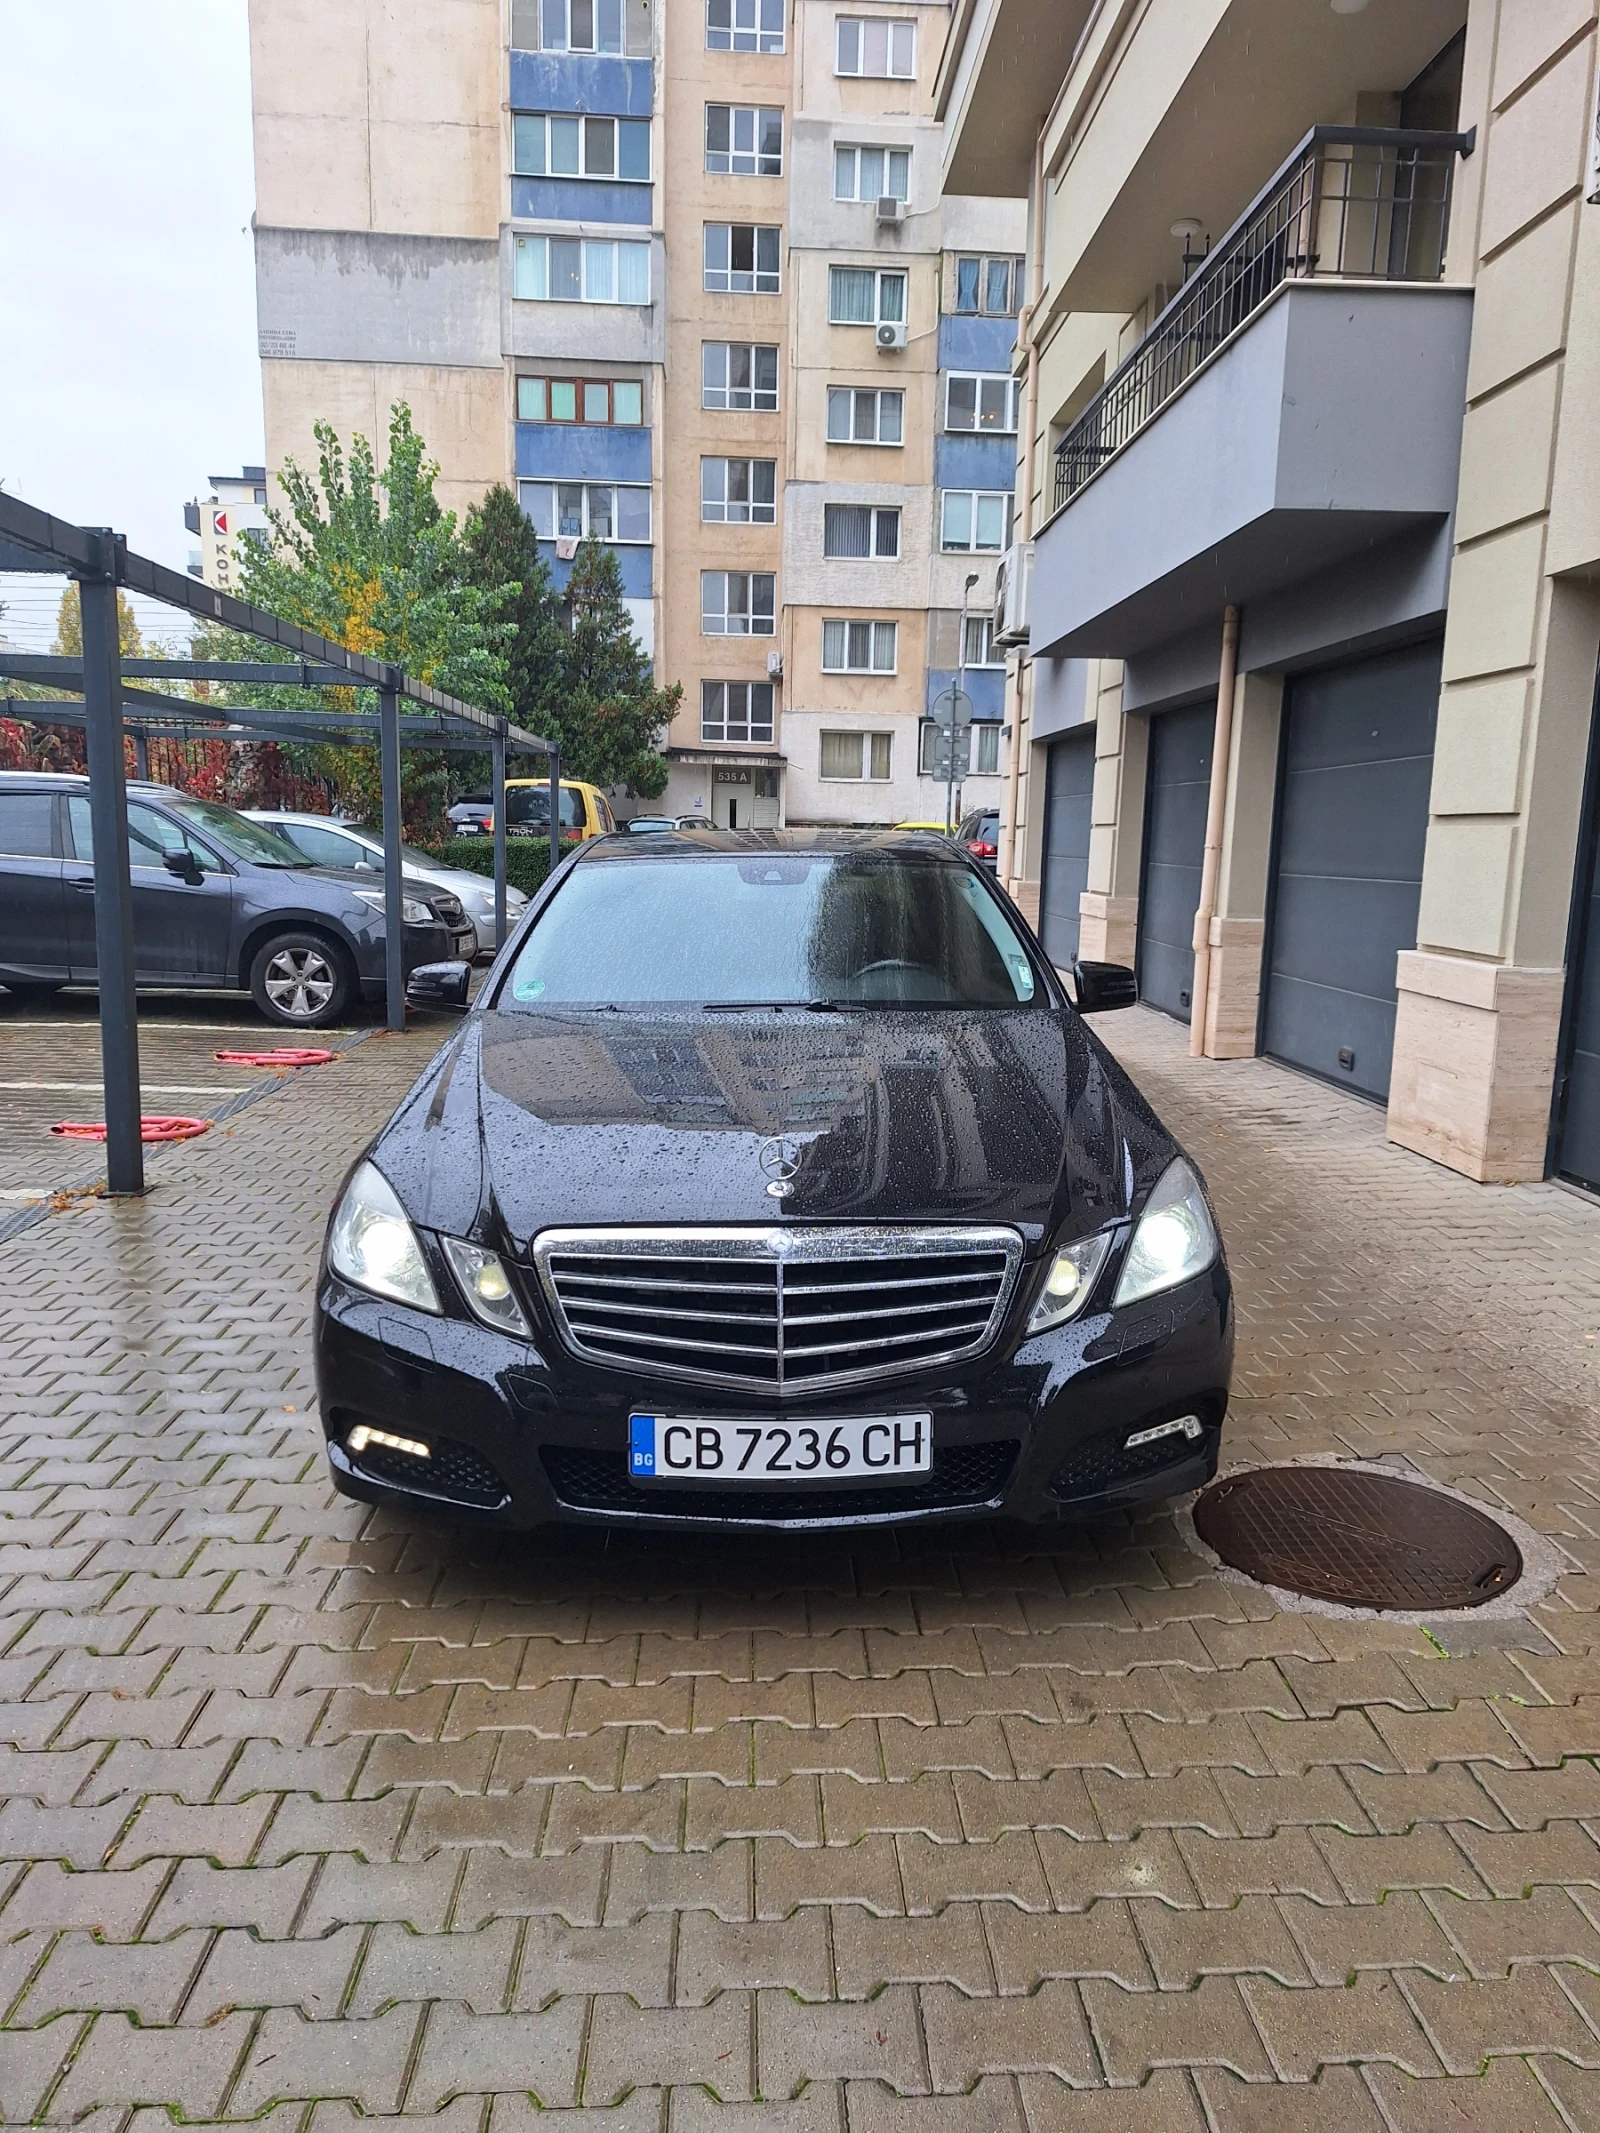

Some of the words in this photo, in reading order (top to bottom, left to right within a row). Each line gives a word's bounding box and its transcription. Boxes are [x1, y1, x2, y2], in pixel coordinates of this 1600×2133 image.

[718, 772, 736, 781] 535
[664, 1426, 724, 1469] CB
[736, 1426, 850, 1471] 7236
[862, 1421, 921, 1467] CH
[634, 1452, 653, 1467] BG
